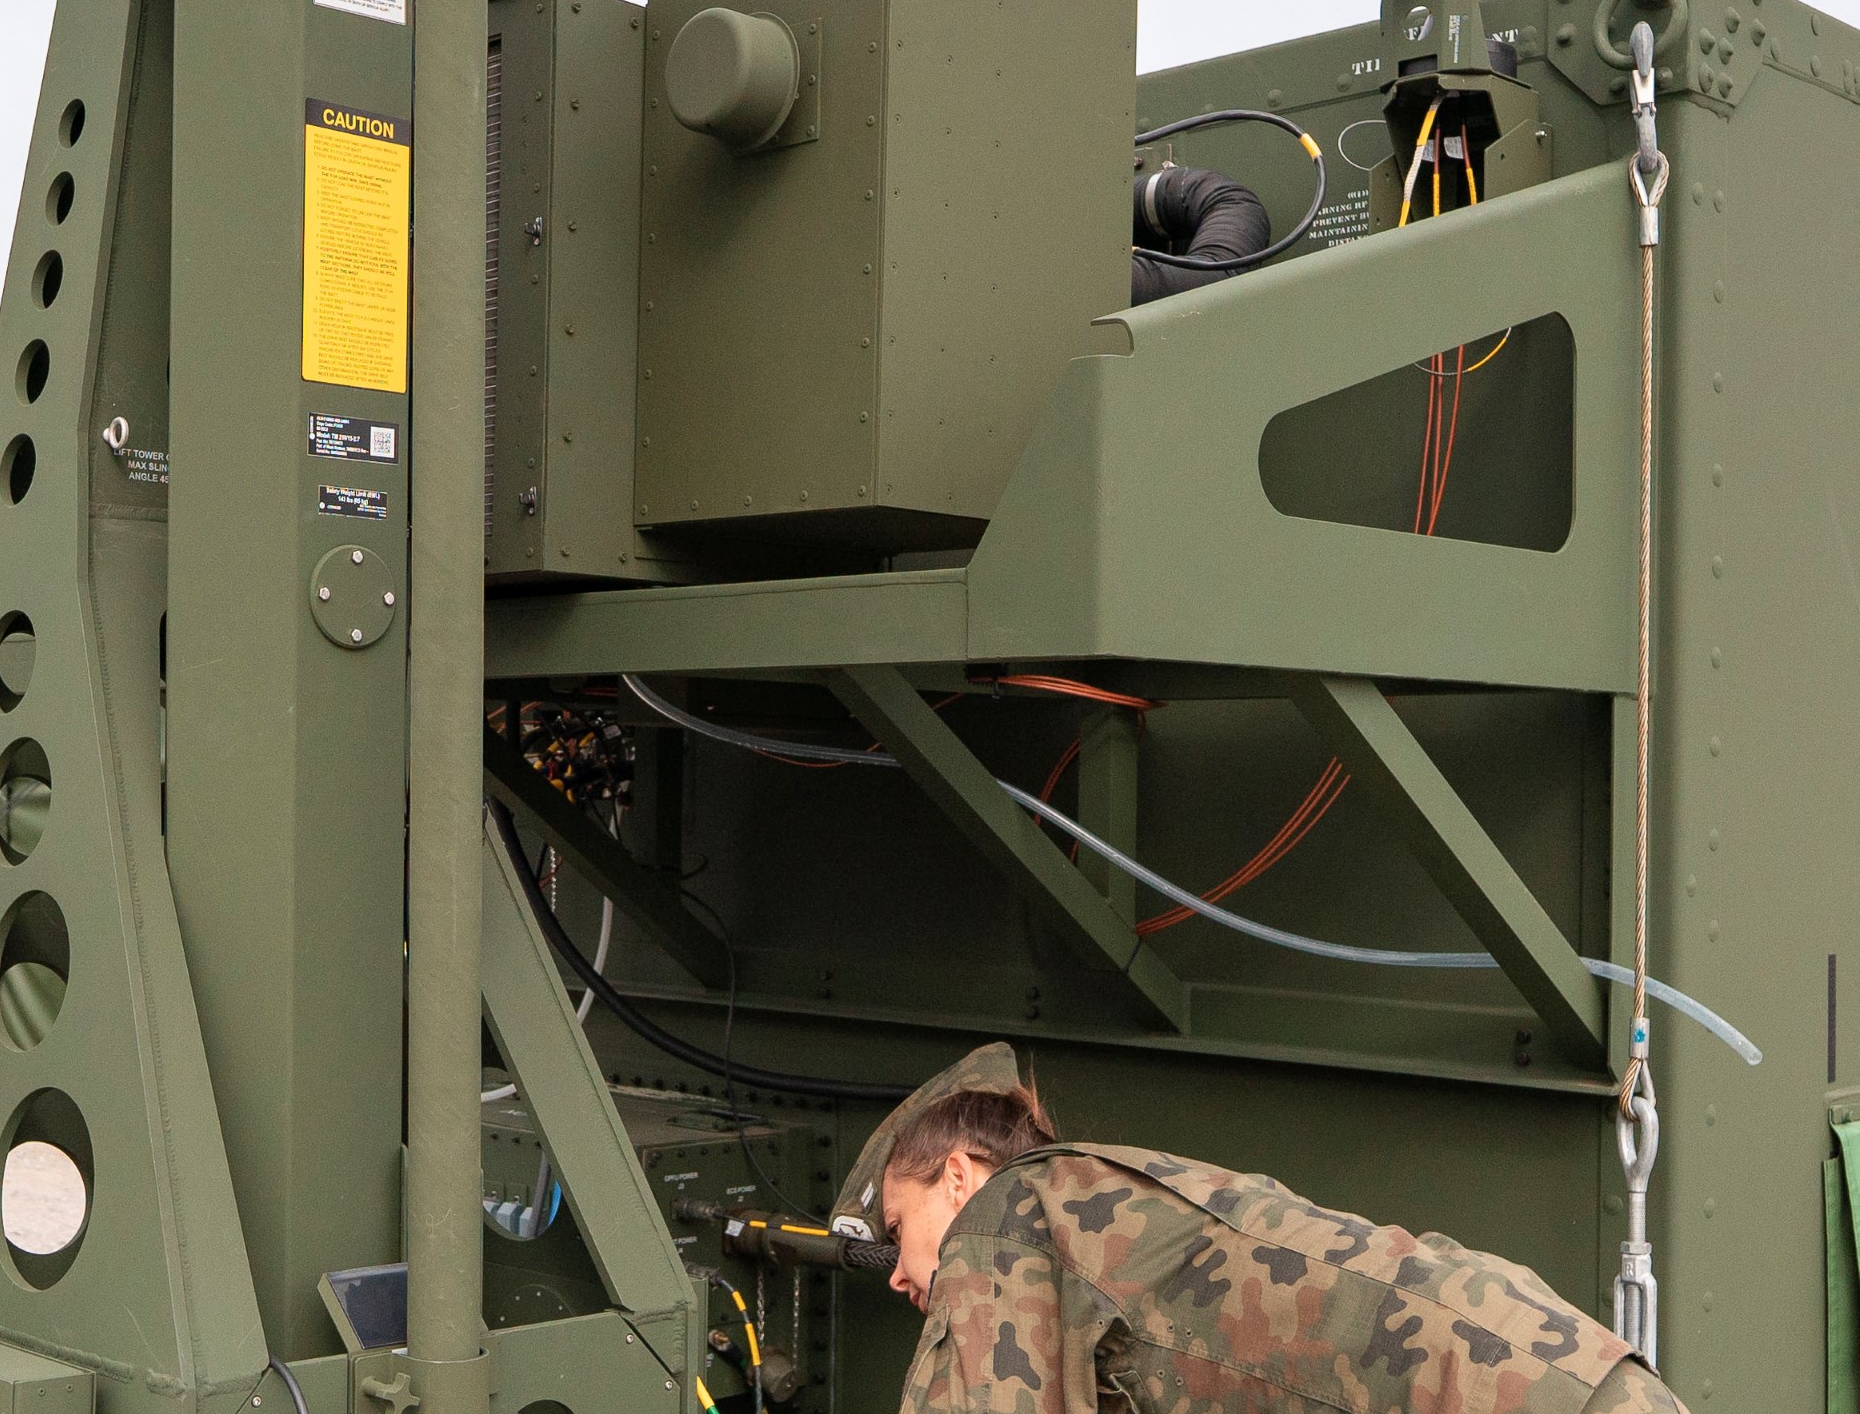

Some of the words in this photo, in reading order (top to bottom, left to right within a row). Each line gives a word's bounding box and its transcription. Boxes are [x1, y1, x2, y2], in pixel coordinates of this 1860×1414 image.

[322, 108, 394, 139] CAUTION
[1312, 214, 1358, 228] PREVENT
[1308, 223, 1369, 240] MAINTAININ
[113, 448, 132, 457] LIFT
[133, 449, 164, 461] TOWER
[127, 460, 147, 470] MAX
[148, 462, 169, 472] SLIN
[128, 471, 159, 483] ANGLE
[159, 475, 169, 484] 45
